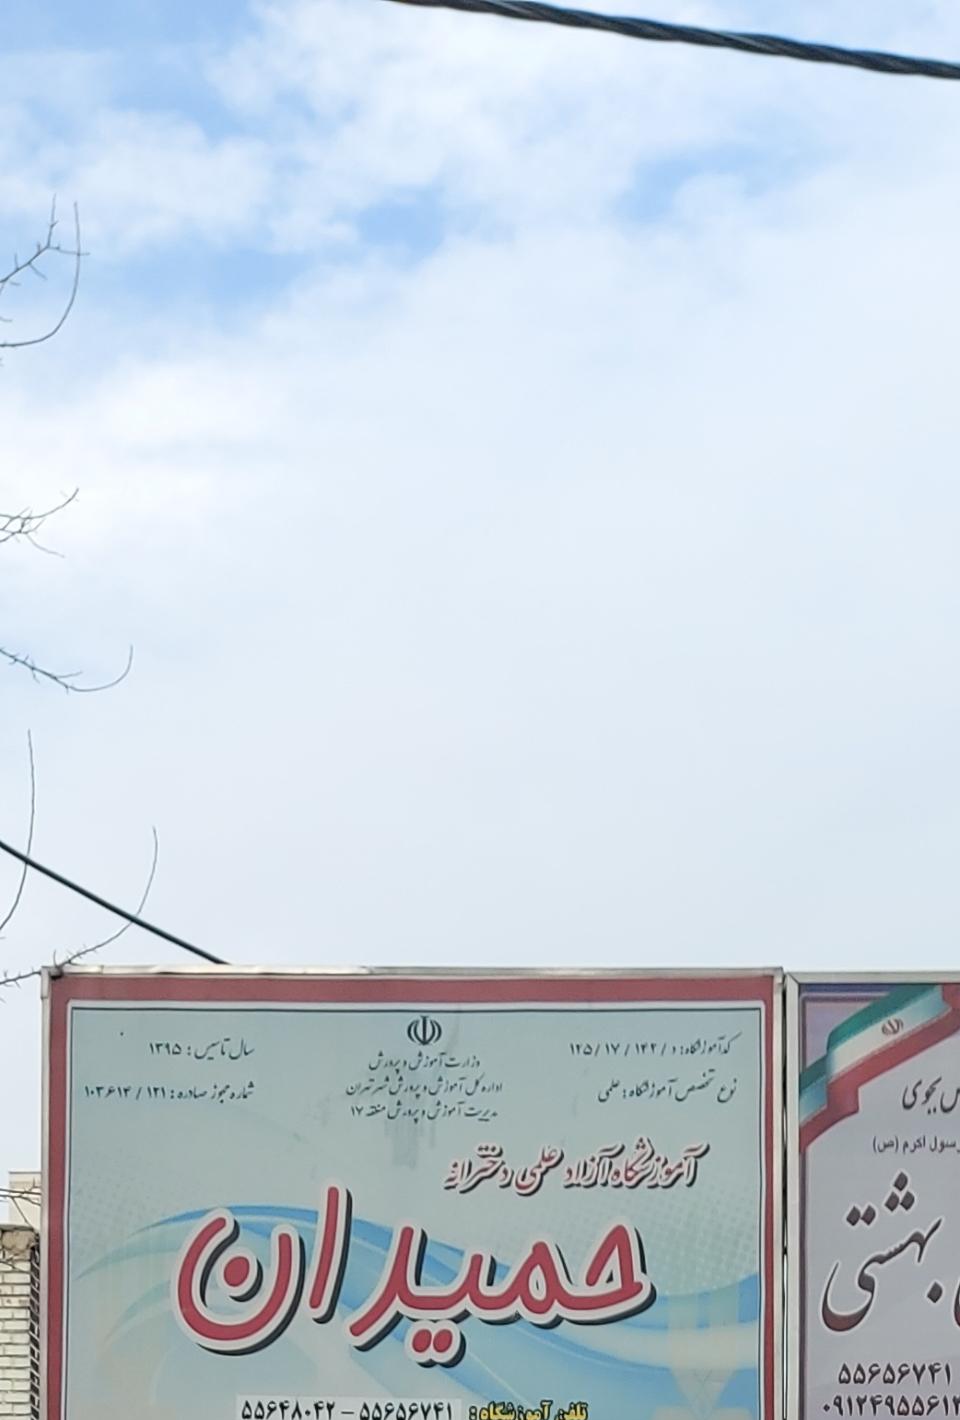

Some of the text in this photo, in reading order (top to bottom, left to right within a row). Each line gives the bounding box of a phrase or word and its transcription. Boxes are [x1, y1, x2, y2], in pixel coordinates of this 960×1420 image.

[149, 1042, 182, 1055] ۱۳۹۵
[229, 1037, 255, 1060] سال
[369, 1050, 400, 1074] پرورش
[408, 1050, 447, 1071] آموزش
[444, 1055, 480, 1068] وزارت
[389, 1075, 421, 1099] پرورش
[428, 1075, 467, 1096] آموزش
[465, 1073, 485, 1096] کل
[481, 1081, 502, 1093] اداره
[598, 1080, 620, 1102] علمی
[717, 1078, 737, 1103] نوع
[366, 1104, 386, 1117] منطقه
[387, 1099, 419, 1124] پرورش
[427, 1100, 465, 1120] آموزش
[464, 1106, 498, 1122] مدیریت
[902, 1136, 926, 1154] اکرم
[443, 1136, 709, 1196] آموزشگاه آزاد علمی دخترانه
[820, 1171, 943, 1332] بهشتی
[838, 1362, 951, 1385] ۵۵۶۵۶۷۴۱
[241, 1399, 335, 1420] ۵۵۶۴۸۰۴۲
